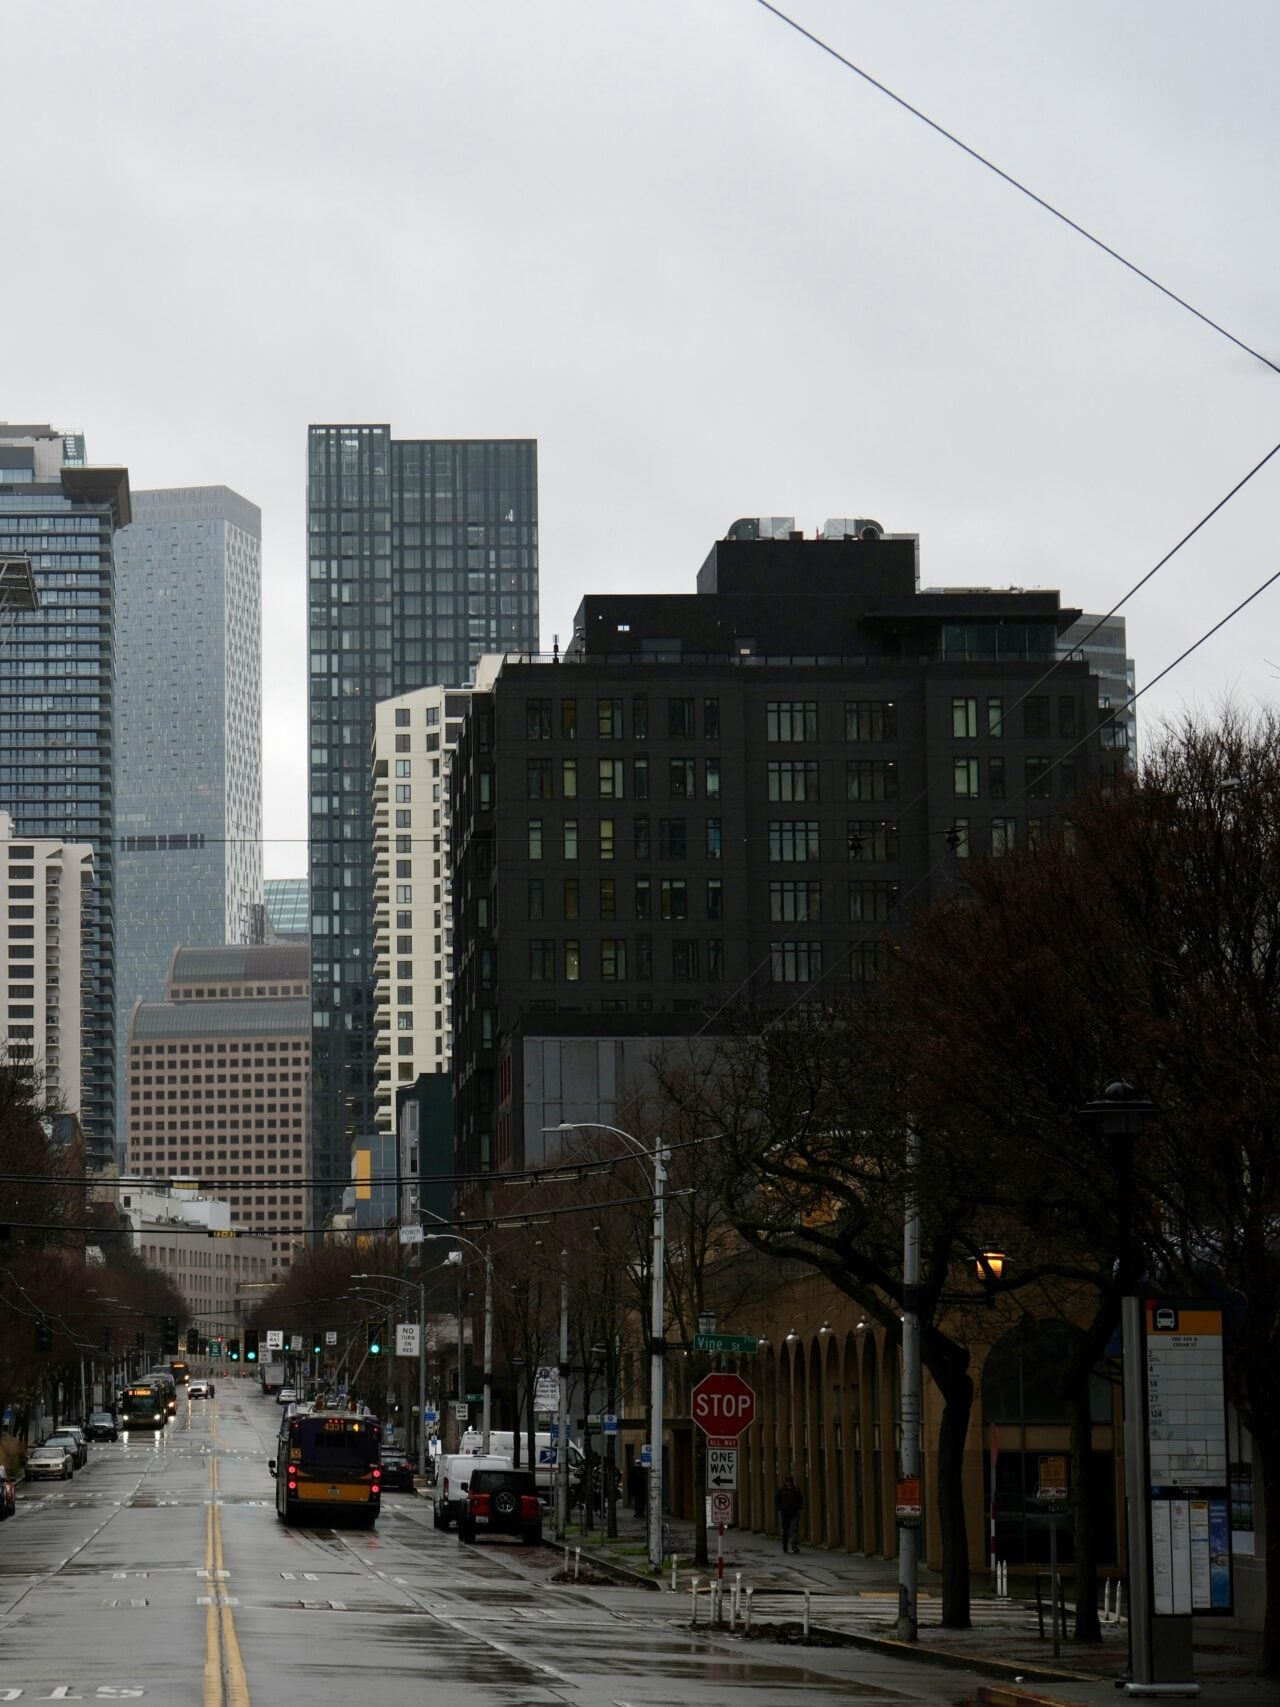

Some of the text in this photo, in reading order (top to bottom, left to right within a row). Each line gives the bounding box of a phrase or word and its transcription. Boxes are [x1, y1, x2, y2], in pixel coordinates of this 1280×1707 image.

[697, 1336, 723, 1350] Vine
[731, 1342, 741, 1352] St
[1148, 1350, 1153, 1358] 2
[695, 1392, 752, 1418] STOP
[324, 1423, 345, 1432] 4331
[709, 1439, 720, 1447] ALL
[711, 1452, 734, 1462] ONE
[710, 1463, 735, 1474] WAY
